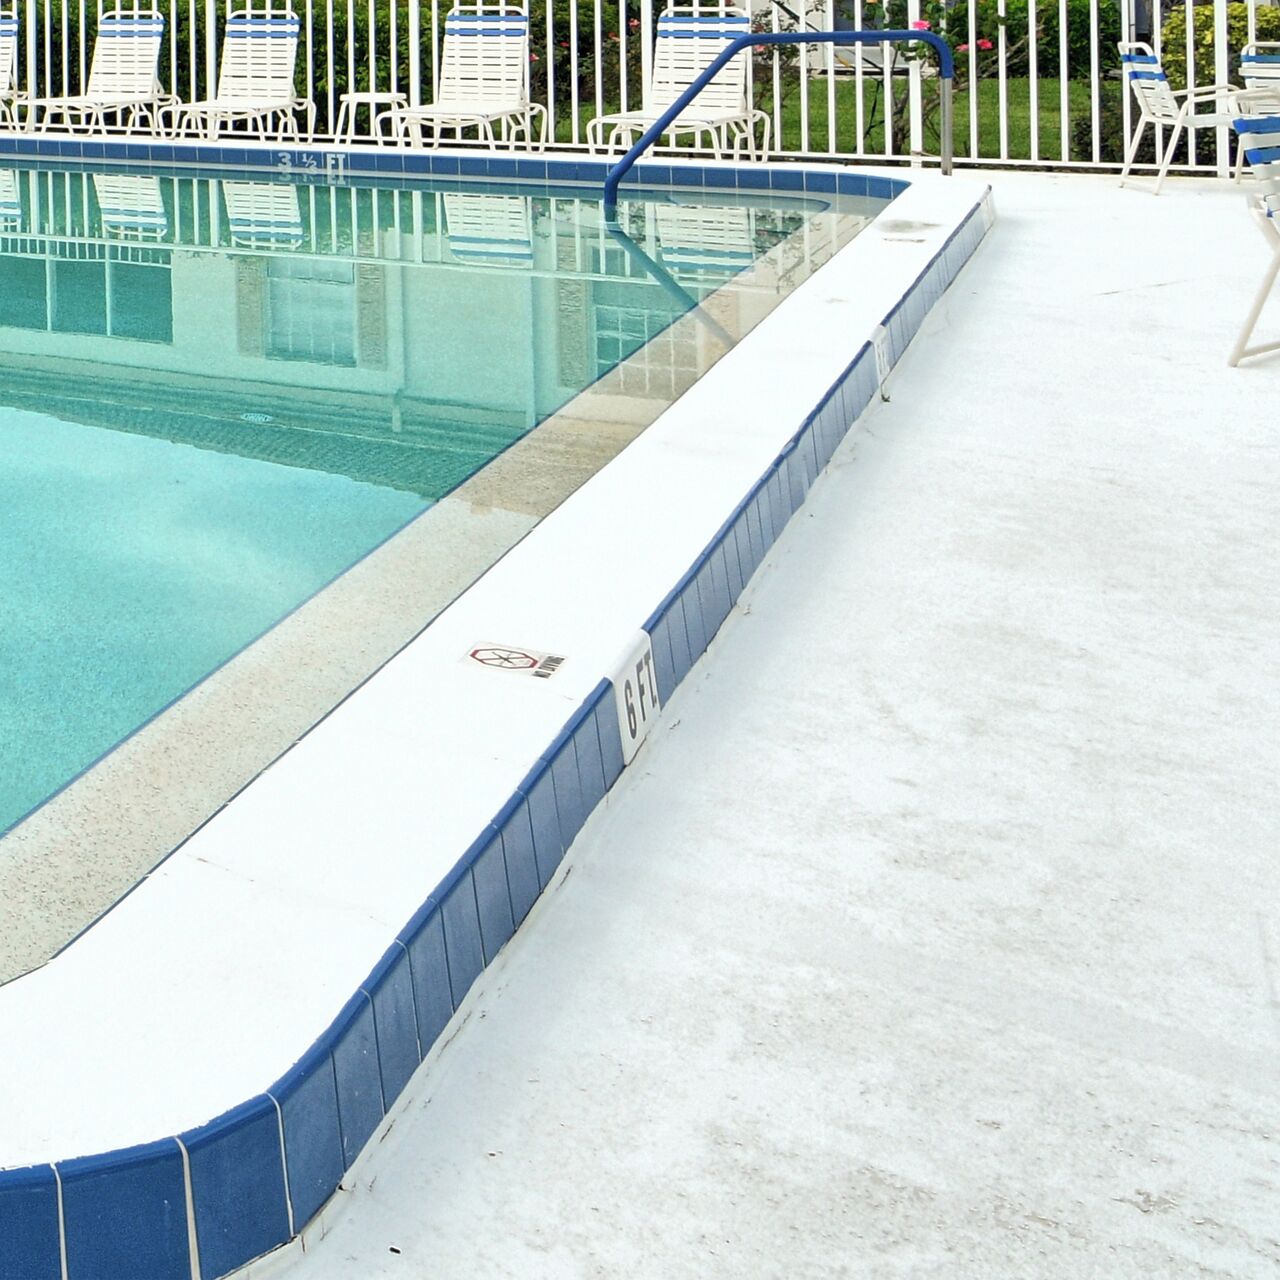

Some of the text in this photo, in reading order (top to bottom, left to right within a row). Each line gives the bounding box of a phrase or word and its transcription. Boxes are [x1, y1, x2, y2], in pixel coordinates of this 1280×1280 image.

[277, 152, 292, 167] 3
[326, 153, 346, 170] FT
[624, 679, 636, 739] 6
